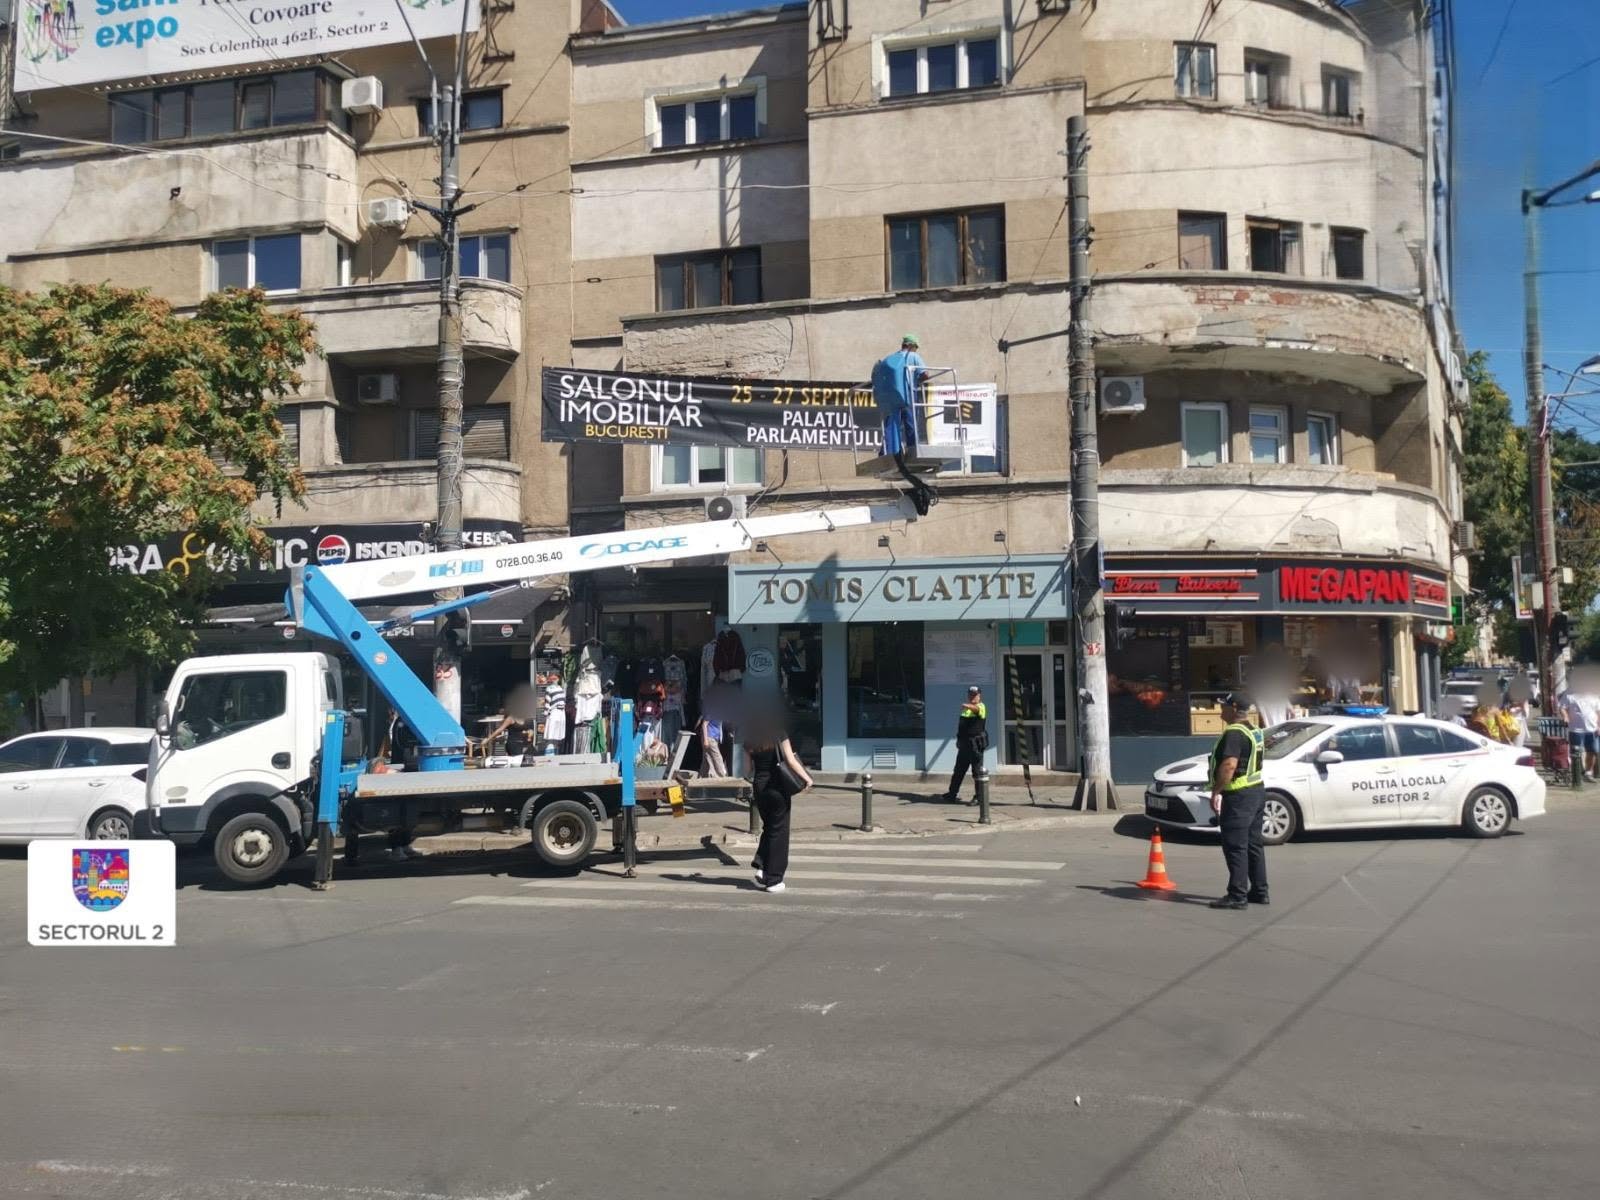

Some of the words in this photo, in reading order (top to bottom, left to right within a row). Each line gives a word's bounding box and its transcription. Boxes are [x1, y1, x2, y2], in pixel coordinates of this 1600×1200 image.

[249, 1, 333, 25] Covoare
[95, 16, 178, 48] expo
[181, 44, 206, 57] Sos
[209, 36, 278, 54] Colentina
[327, 22, 376, 38] Sector
[380, 21, 389, 31] 2
[560, 374, 702, 404] SALONUL
[731, 385, 753, 404] 25
[773, 387, 794, 404] 27
[560, 400, 703, 427] IMOBILIAR
[585, 424, 668, 439] BUCURESTI
[319, 548, 346, 557] PEPSI
[495, 551, 563, 569] 0728.00.36.40
[758, 576, 864, 605] TOMIS
[882, 572, 1037, 602] CLATITE
[1280, 566, 1410, 603] MEGAPAN
[1352, 779, 1398, 791] POLITIA
[1401, 775, 1447, 787] LOCALA
[1372, 792, 1419, 805] SECTOR
[1423, 791, 1430, 801] 2
